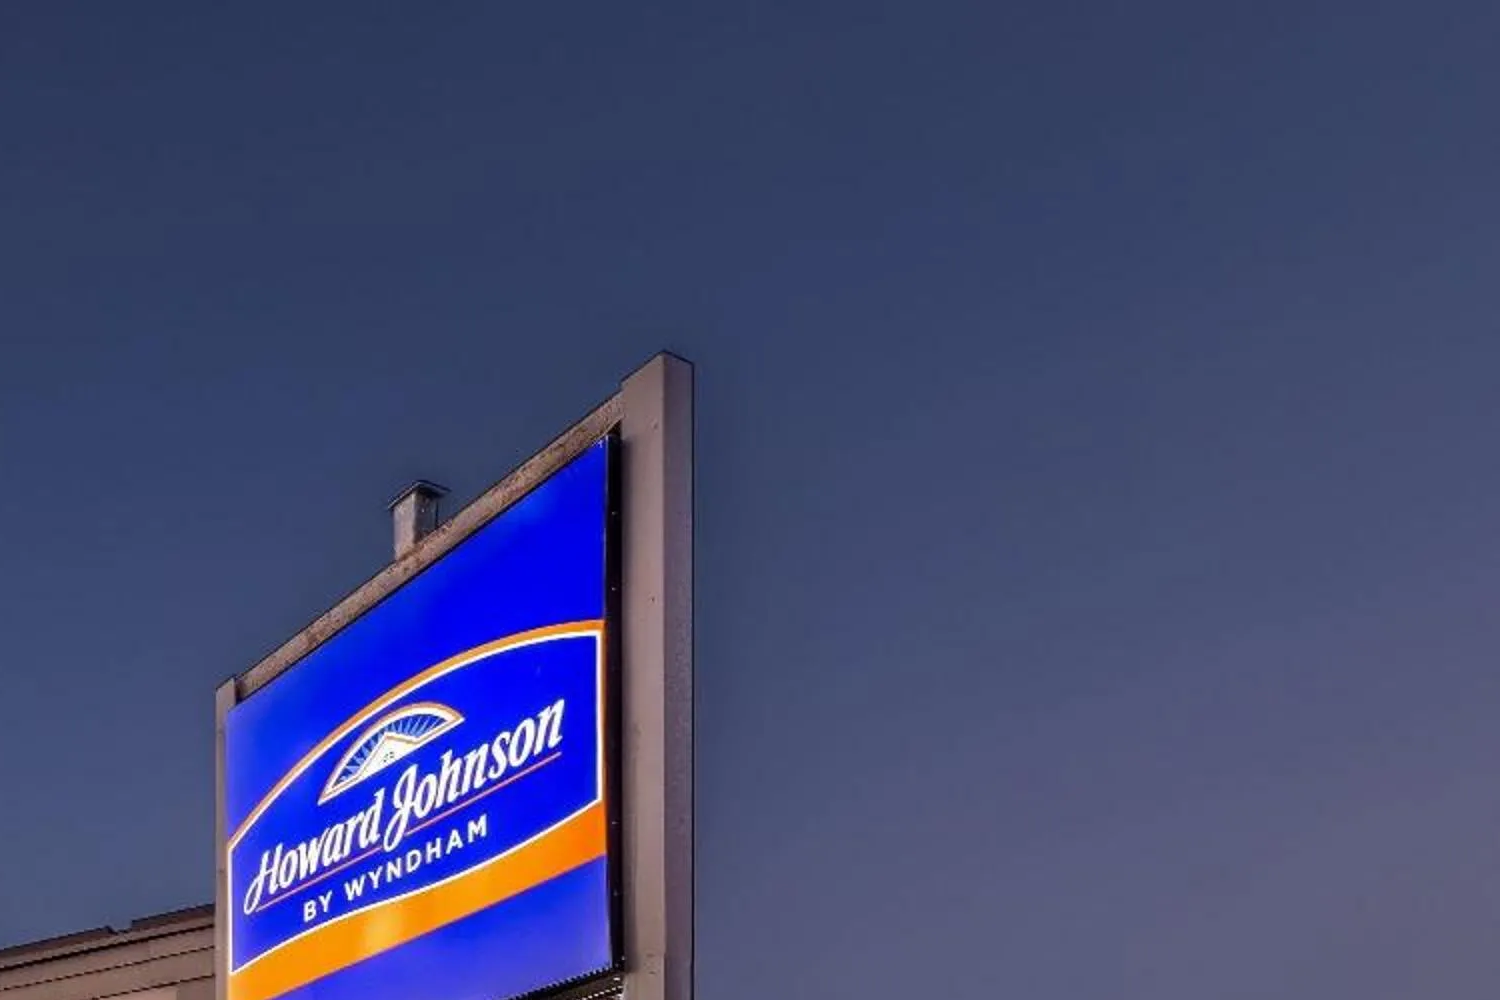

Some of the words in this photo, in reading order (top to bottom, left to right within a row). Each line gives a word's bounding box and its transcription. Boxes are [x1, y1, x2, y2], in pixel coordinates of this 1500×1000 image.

[244, 787, 386, 916] Howard
[383, 699, 565, 852] Johnson
[303, 890, 333, 923] BY
[344, 813, 489, 901] WYNDHAM
